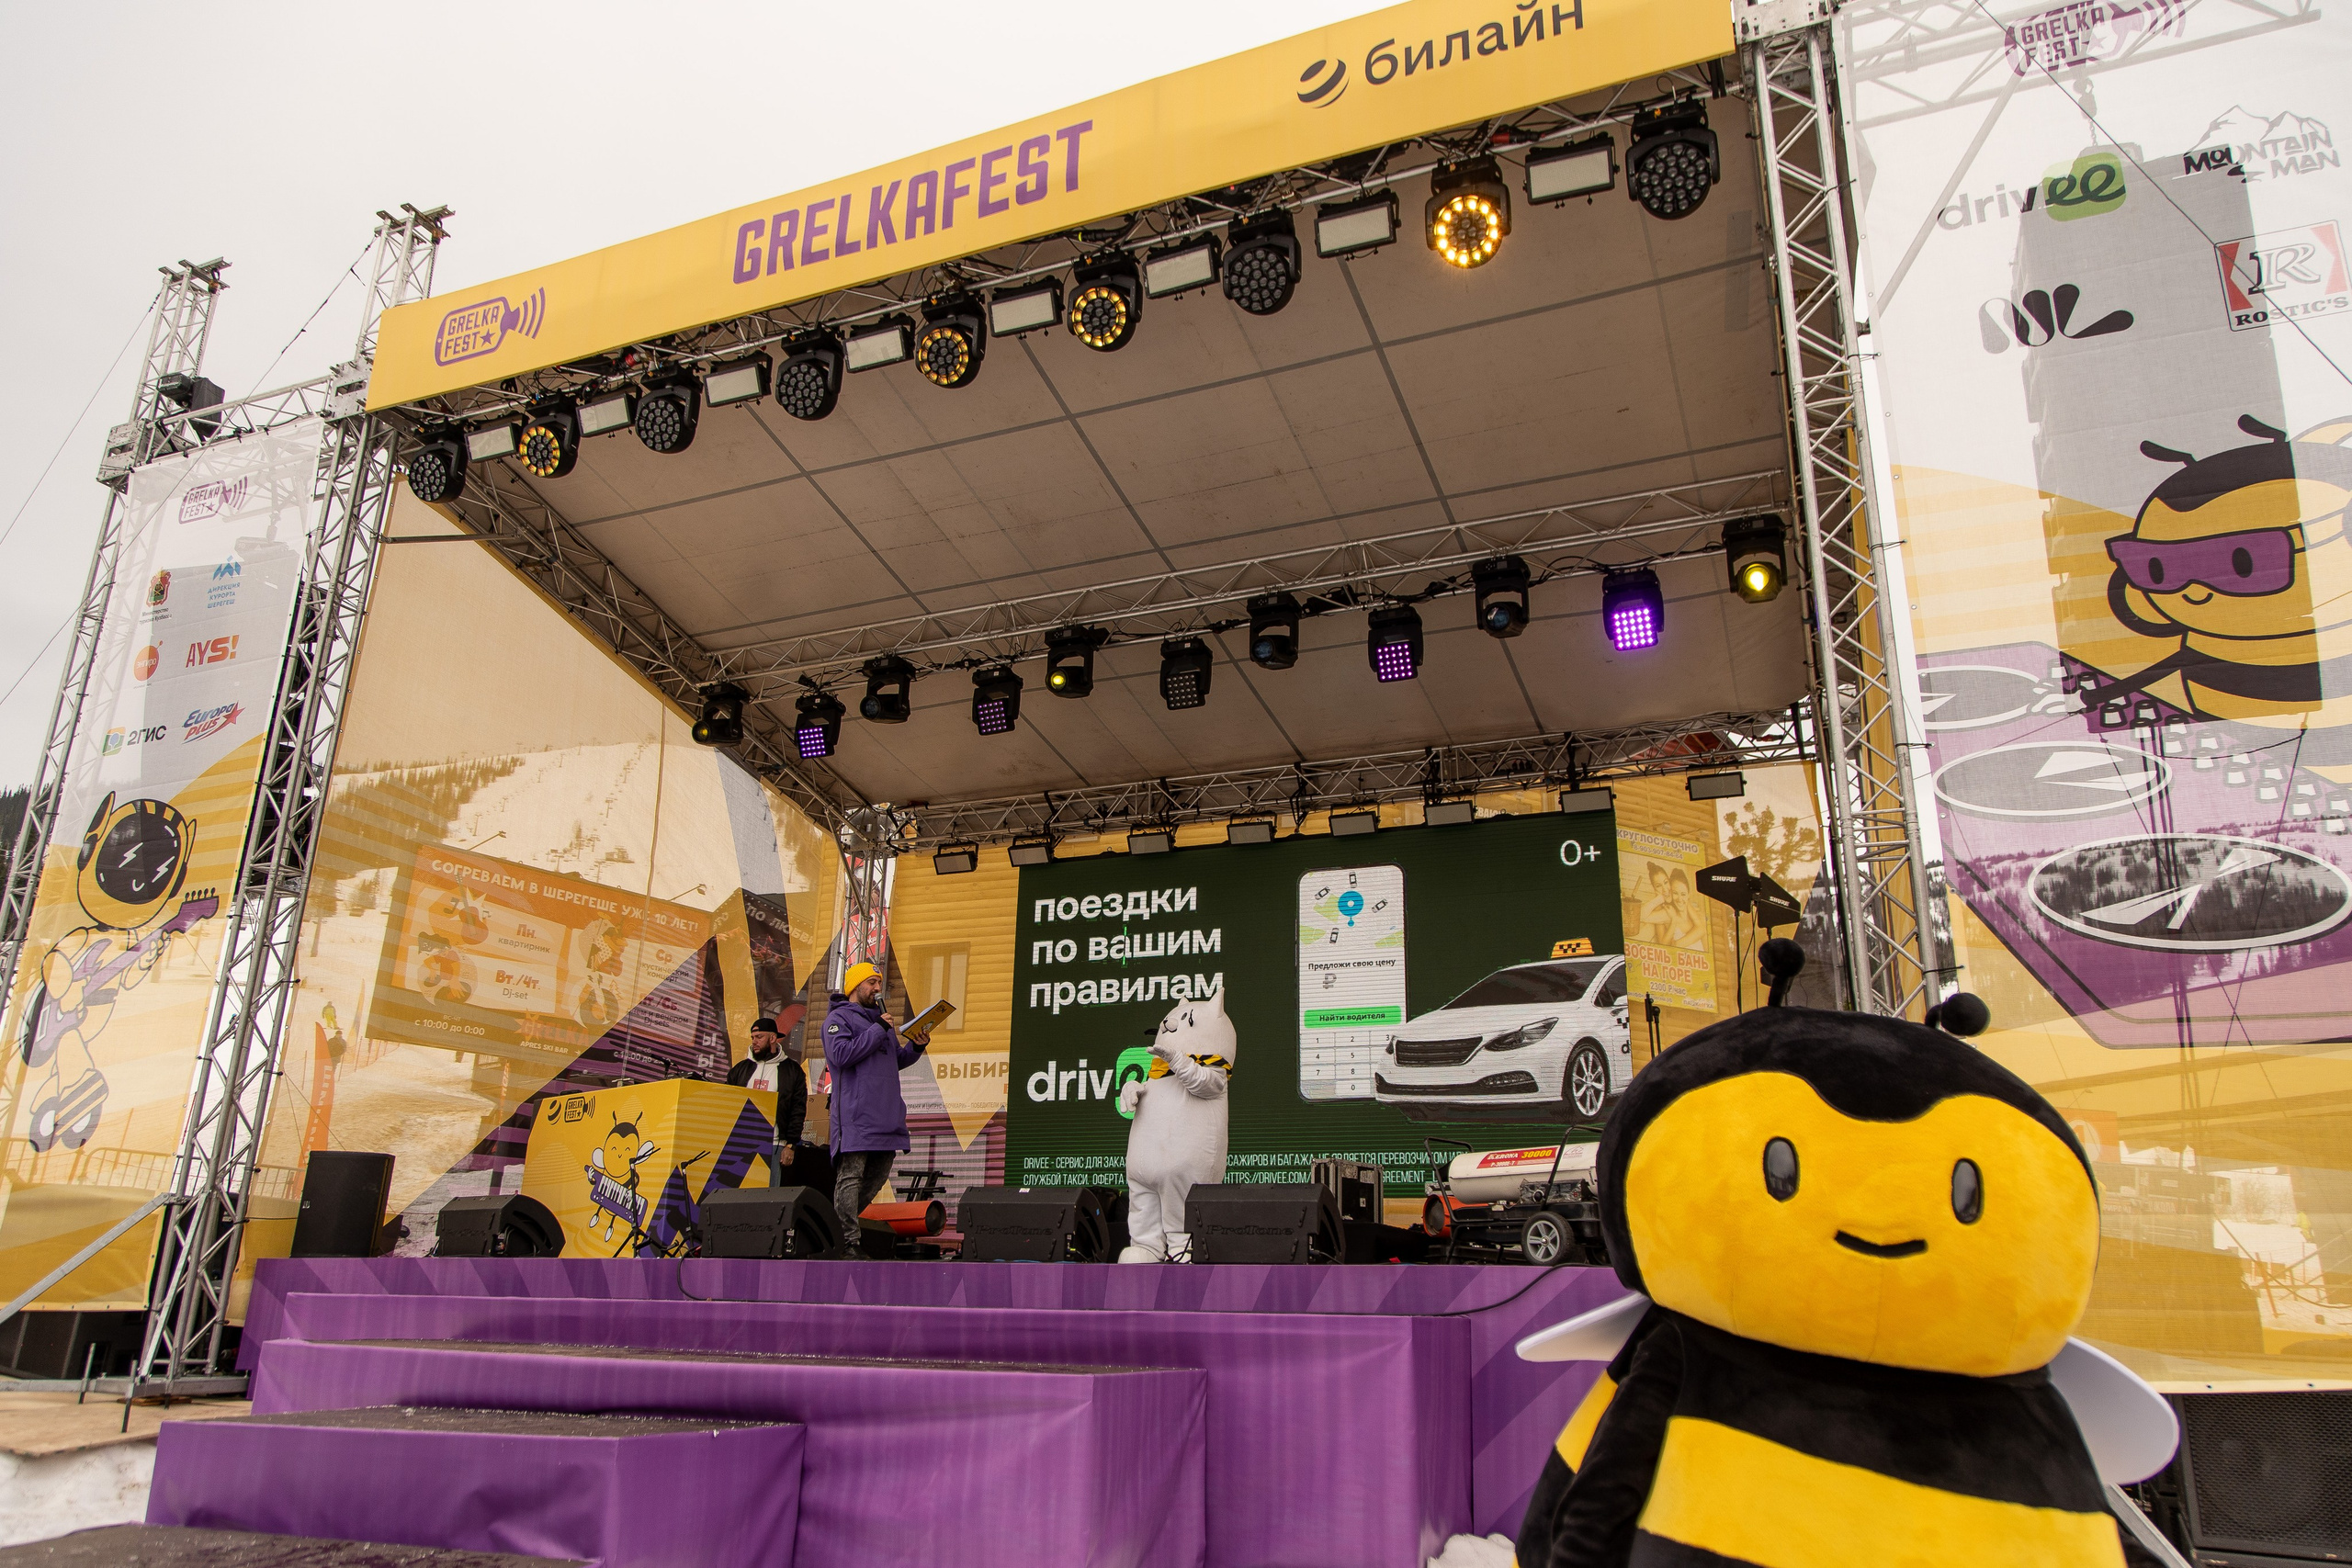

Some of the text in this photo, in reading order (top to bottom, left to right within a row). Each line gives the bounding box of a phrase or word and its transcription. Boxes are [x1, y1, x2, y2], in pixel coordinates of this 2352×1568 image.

[2020, 6, 2105, 46] GRELKA
[1363, 0, 1584, 85] билайн
[2024, 37, 2080, 68] FEST
[2183, 130, 2334, 175] MOUNTAIN
[2271, 150, 2342, 180] MAN
[732, 119, 1094, 284] GRELKAFEST
[1936, 164, 2127, 231] drivee
[2234, 296, 2350, 327] ROSTIC'S
[447, 305, 500, 336] GRELKA
[444, 331, 481, 358] FEST
[187, 486, 220, 504] GRELKA
[184, 505, 207, 519] FEST
[207, 582, 241, 594] ДИРЕКЦИЯ
[209, 591, 236, 601] КУРОРТА
[207, 599, 235, 609] ШЕРЕГЕШ
[186, 635, 240, 668] AYS!
[127, 725, 167, 746] 2ГИС
[1617, 829, 1699, 854] КРУГЛОСУТОЧНО
[1560, 840, 1601, 866] 0+
[432, 859, 525, 891] СОГРЕВАЕМ
[529, 882, 538, 894] В
[543, 886, 618, 913] ШЕРЕГЕШЕ
[655, 913, 667, 925] 10
[670, 915, 699, 932] ЛЕТ!
[1035, 886, 1197, 922] поездки
[1770, 896, 1791, 907] SHURE
[516, 923, 537, 939] Пн.
[498, 936, 551, 953] квартирник
[1032, 928, 1222, 964] по вашим
[655, 949, 674, 964] Ср.
[1308, 961, 1351, 971] Предложи
[1375, 959, 1396, 967] цену
[1624, 942, 1710, 971] ВОСЕМЬ БАНЬ
[639, 963, 690, 977] кустический
[1643, 962, 1692, 984] НА ГОРЕ
[502, 987, 528, 1000] Dj-set
[1030, 972, 1224, 1014] правилам
[1649, 981, 1667, 992] 2300
[1319, 1012, 1385, 1021] Найти водителя
[423, 1019, 448, 1030] 10:00
[450, 1024, 462, 1032] до
[464, 1025, 485, 1036] 0:00
[520, 1040, 569, 1055] APRES SKI BAR
[568, 1100, 583, 1110] GRELKA
[567, 1110, 578, 1119] FEST
[1023, 1157, 1049, 1169] DRIVEE
[1056, 1156, 1084, 1168] СЕРВИС
[1085, 1156, 1102, 1168] ДЛЯ
[1103, 1156, 1126, 1168] ЗАКА
[1270, 1154, 1276, 1166] И
[1378, 1151, 1448, 1165] ПЕРЕВОЗЧИОМ
[1487, 1152, 1519, 1161] KERONA
[1521, 1149, 1553, 1159] 30000
[1023, 1172, 1125, 1186] СЛУЖБОЙ ТАКСИ. ОФЕРТА
[974, 1224, 1054, 1236] ProTone
[1205, 1224, 1295, 1236] ProTone
